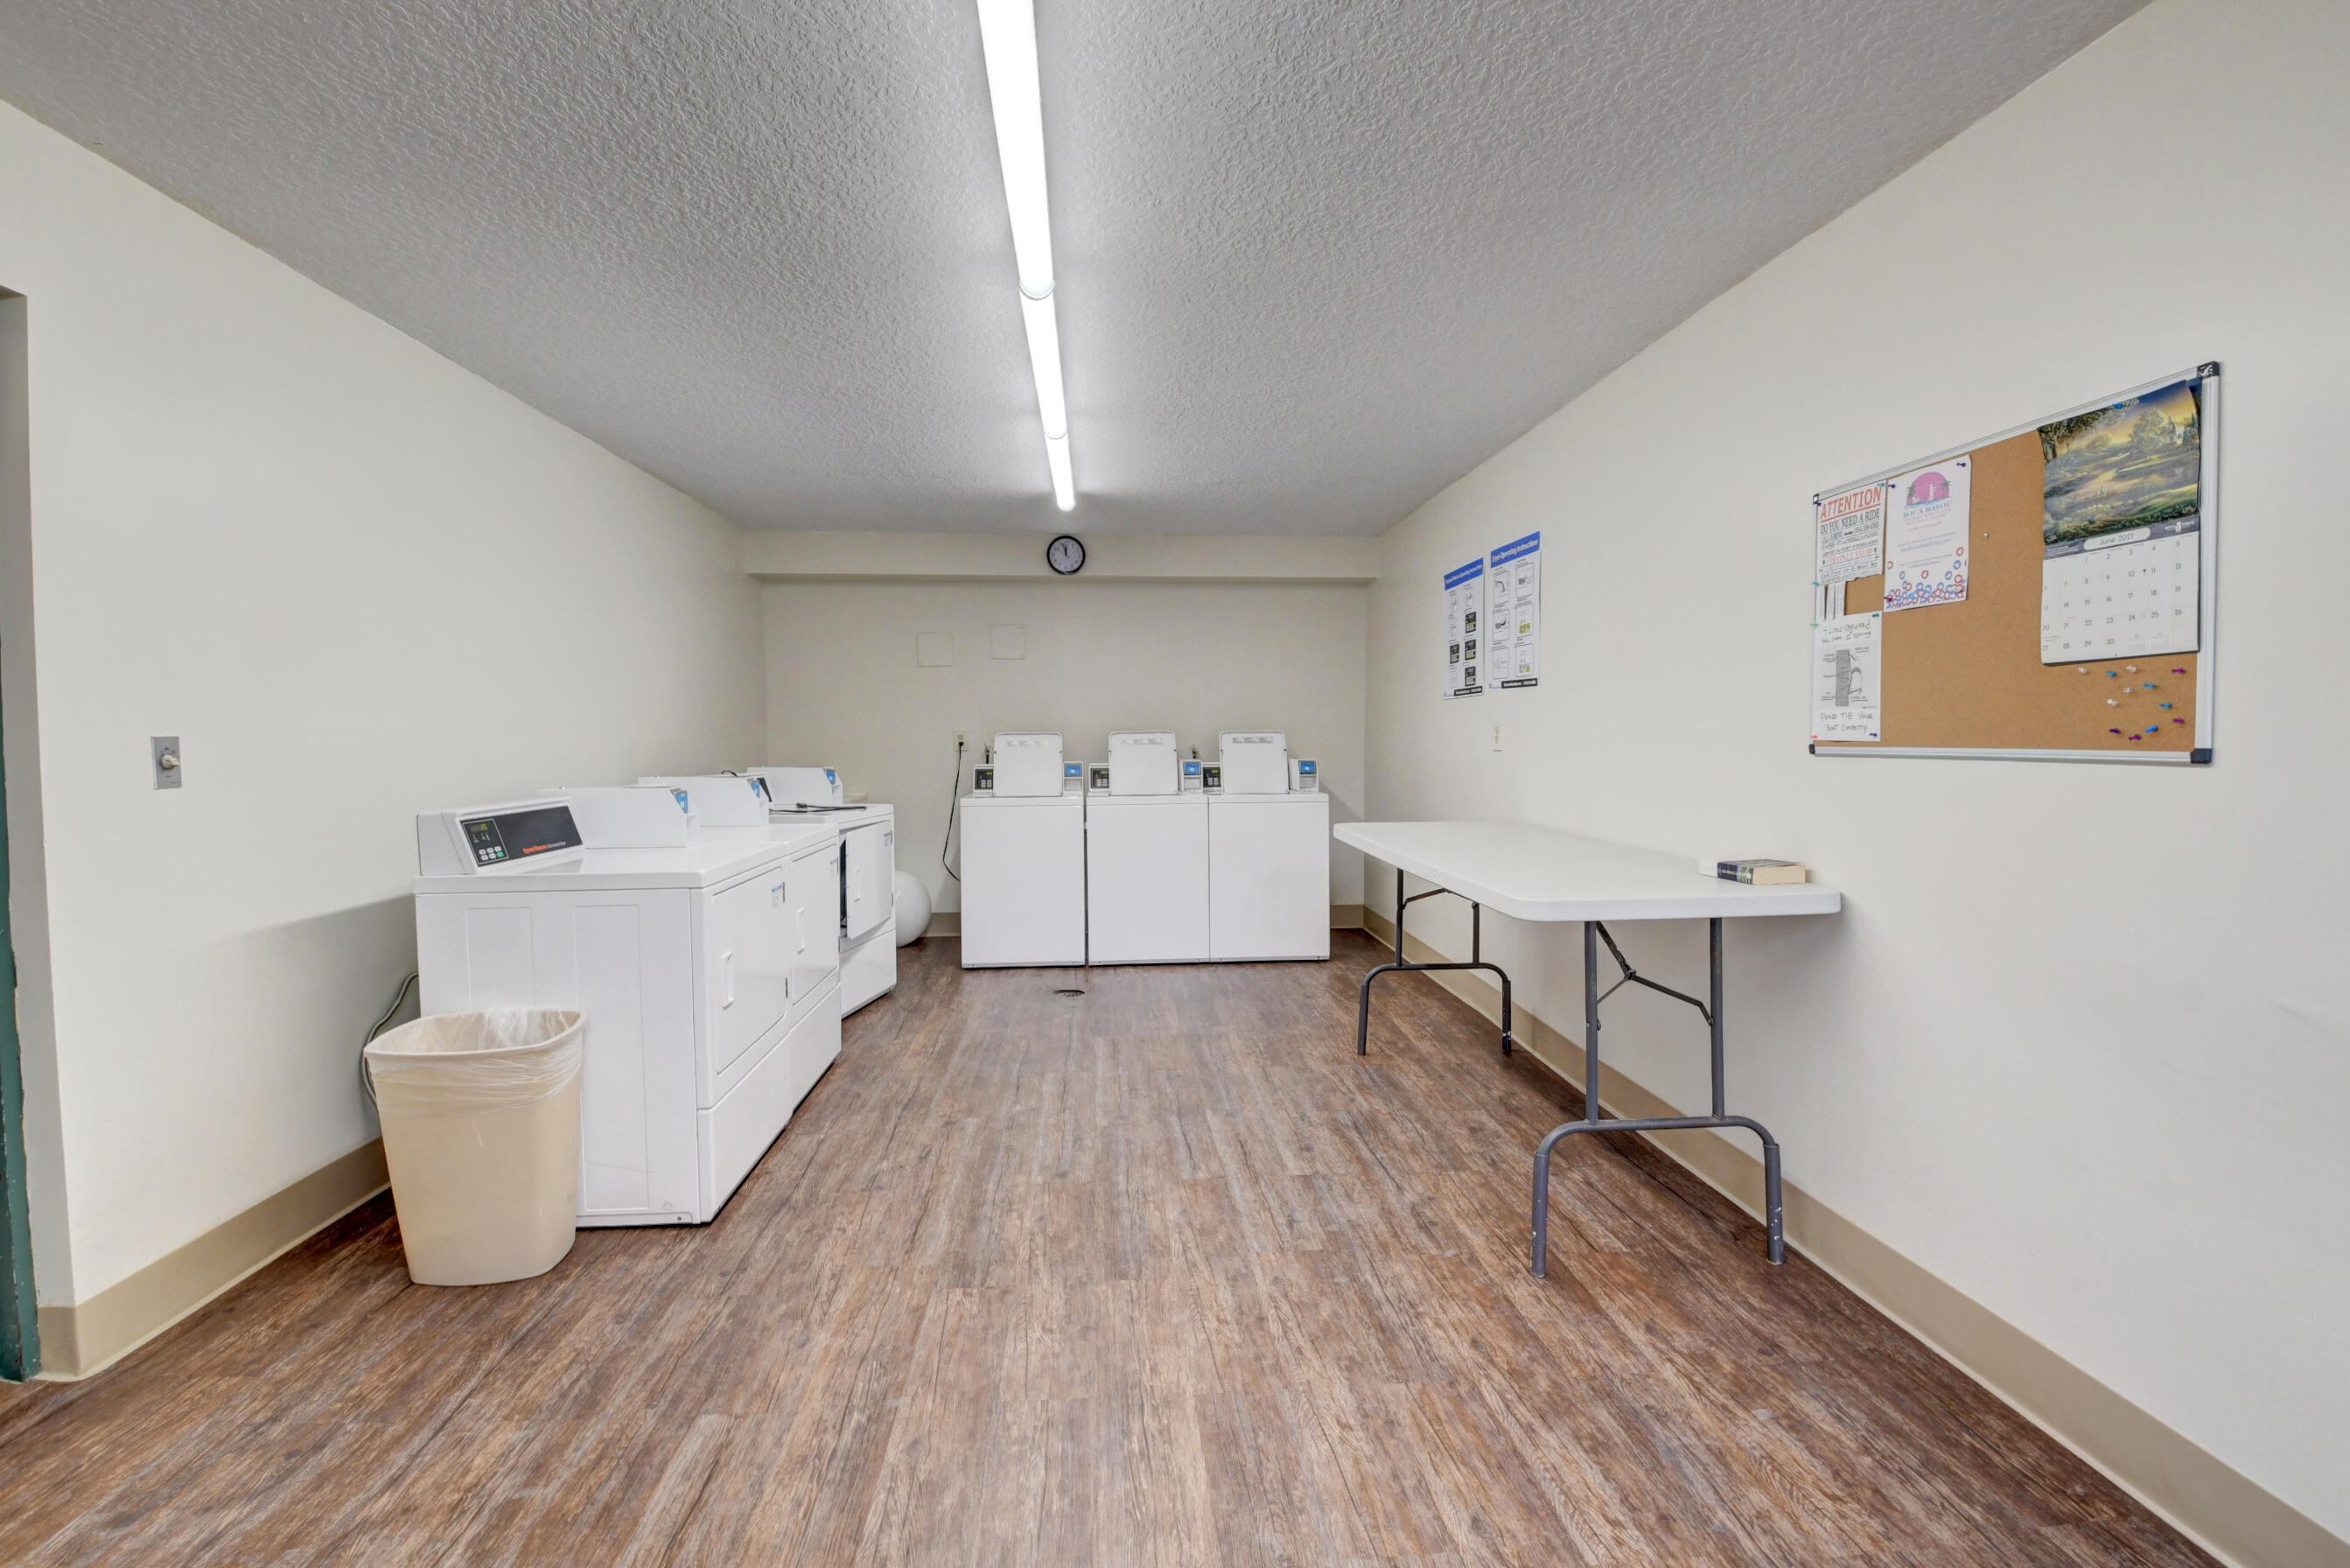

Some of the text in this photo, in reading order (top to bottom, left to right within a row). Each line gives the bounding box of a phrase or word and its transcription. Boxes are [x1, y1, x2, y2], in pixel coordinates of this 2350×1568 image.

[1820, 486, 1882, 520] ATTENTION
[1821, 524, 1829, 536] DO
[1829, 520, 1840, 532] YOU
[1841, 514, 1858, 528] NEED
[1859, 513, 1864, 523] A
[1865, 508, 1880, 522] RIDE
[2100, 533, 2134, 546] June 2021
[2175, 562, 2182, 571] 12
[2174, 584, 2182, 593] 19
[2128, 613, 2136, 622] 24
[2151, 611, 2160, 620] 25
[2106, 637, 2115, 646] 30
